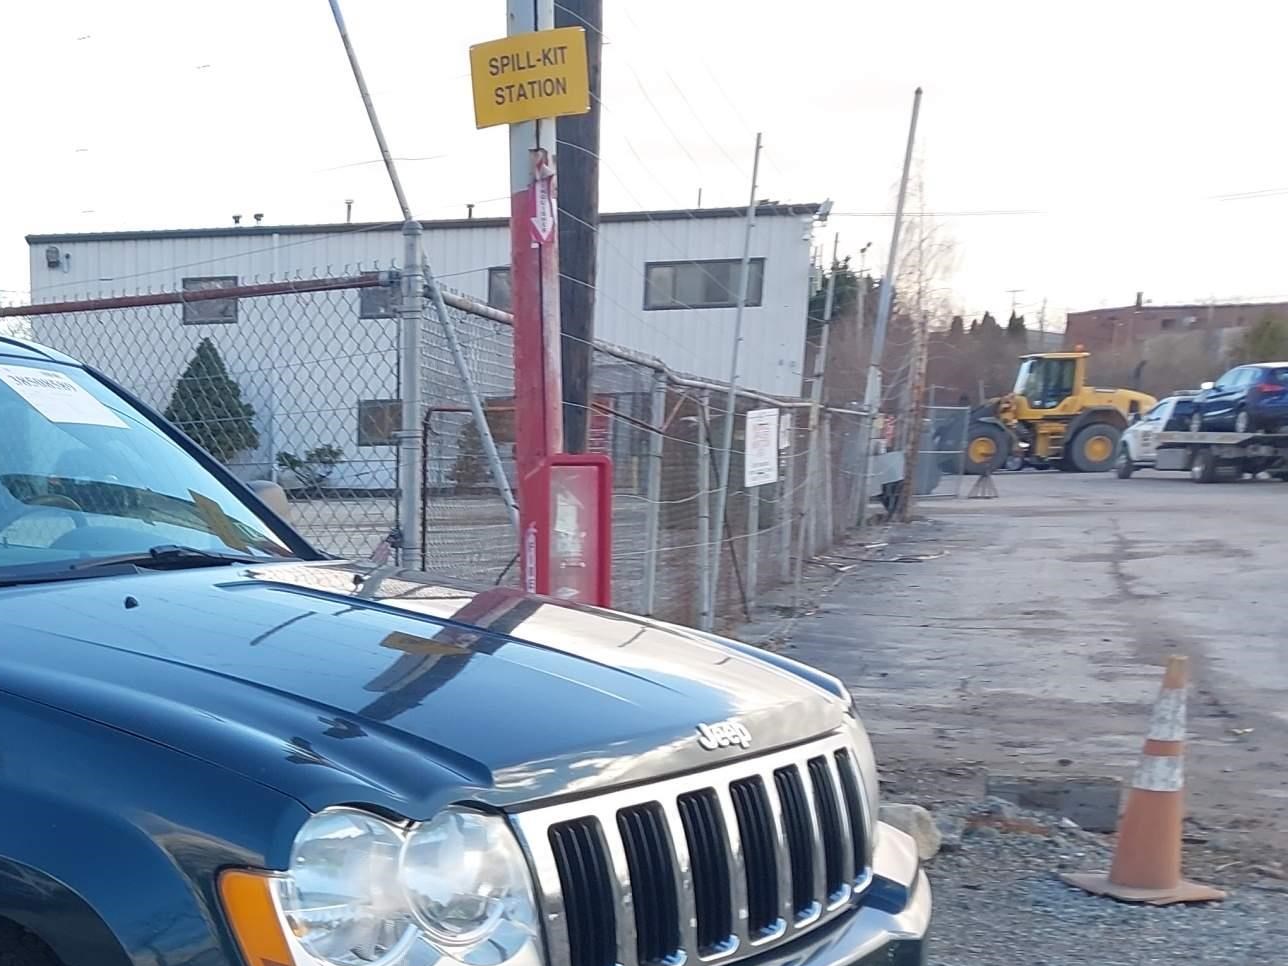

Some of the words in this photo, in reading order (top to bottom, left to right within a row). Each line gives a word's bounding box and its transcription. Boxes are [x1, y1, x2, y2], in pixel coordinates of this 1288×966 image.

[488, 46, 568, 76] SPILL-KIT
[494, 77, 567, 105] STATION
[695, 721, 753, 751] Jeep
